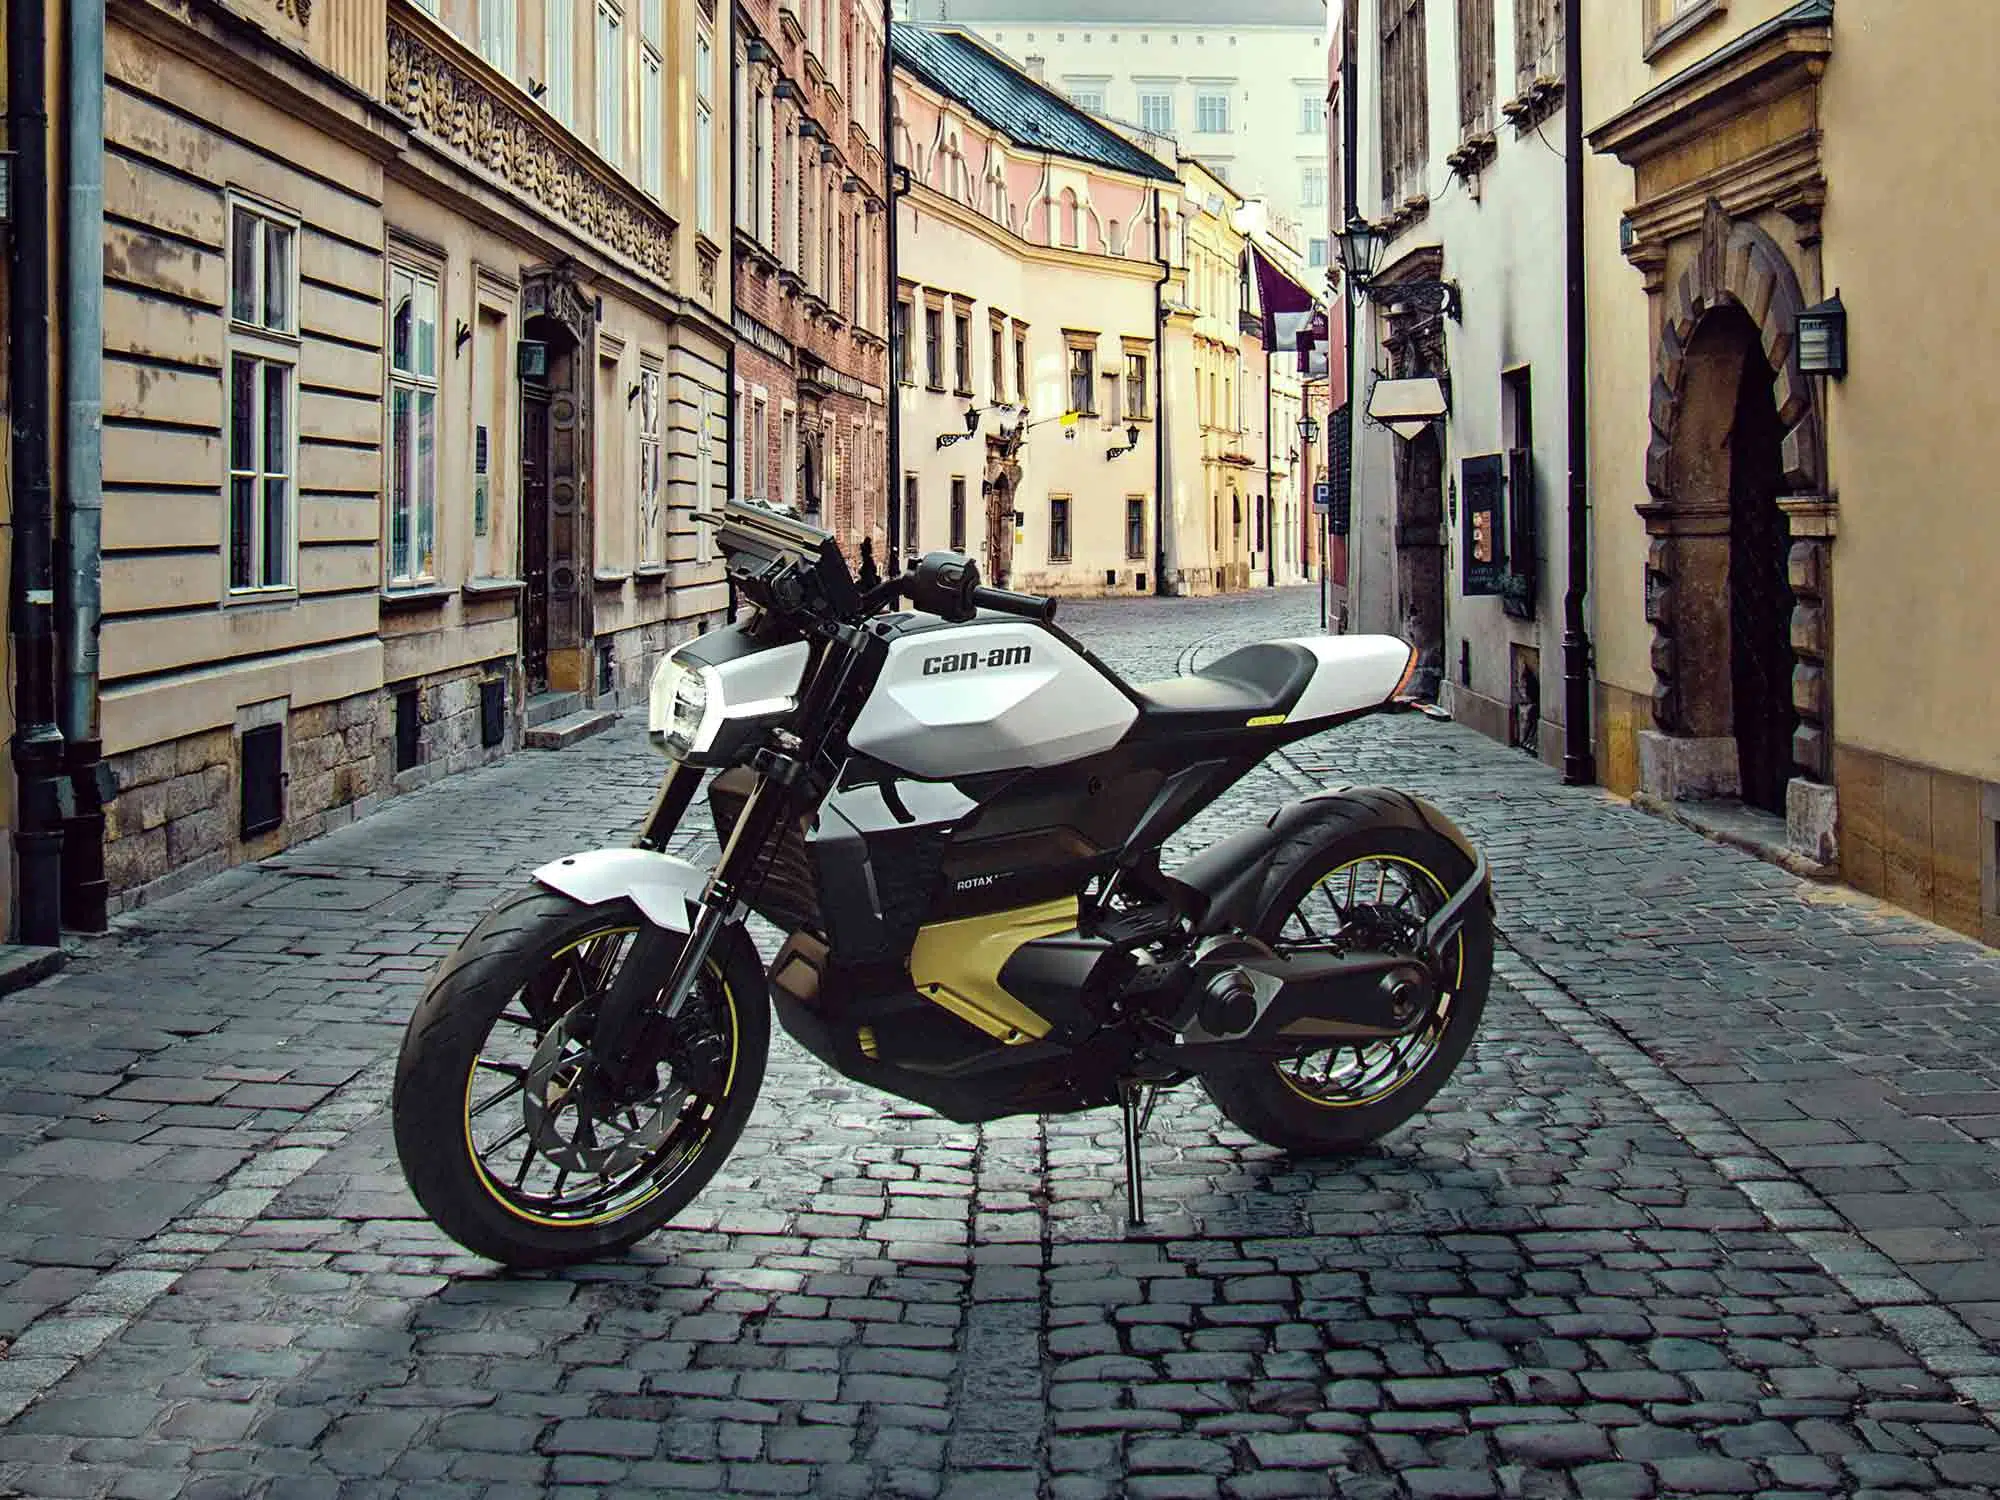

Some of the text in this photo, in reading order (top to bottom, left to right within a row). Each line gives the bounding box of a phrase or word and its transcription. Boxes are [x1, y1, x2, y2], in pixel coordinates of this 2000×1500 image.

[1317, 485, 1329, 501] P
[922, 645, 1032, 676] can-am
[957, 875, 993, 891] ROTAX
